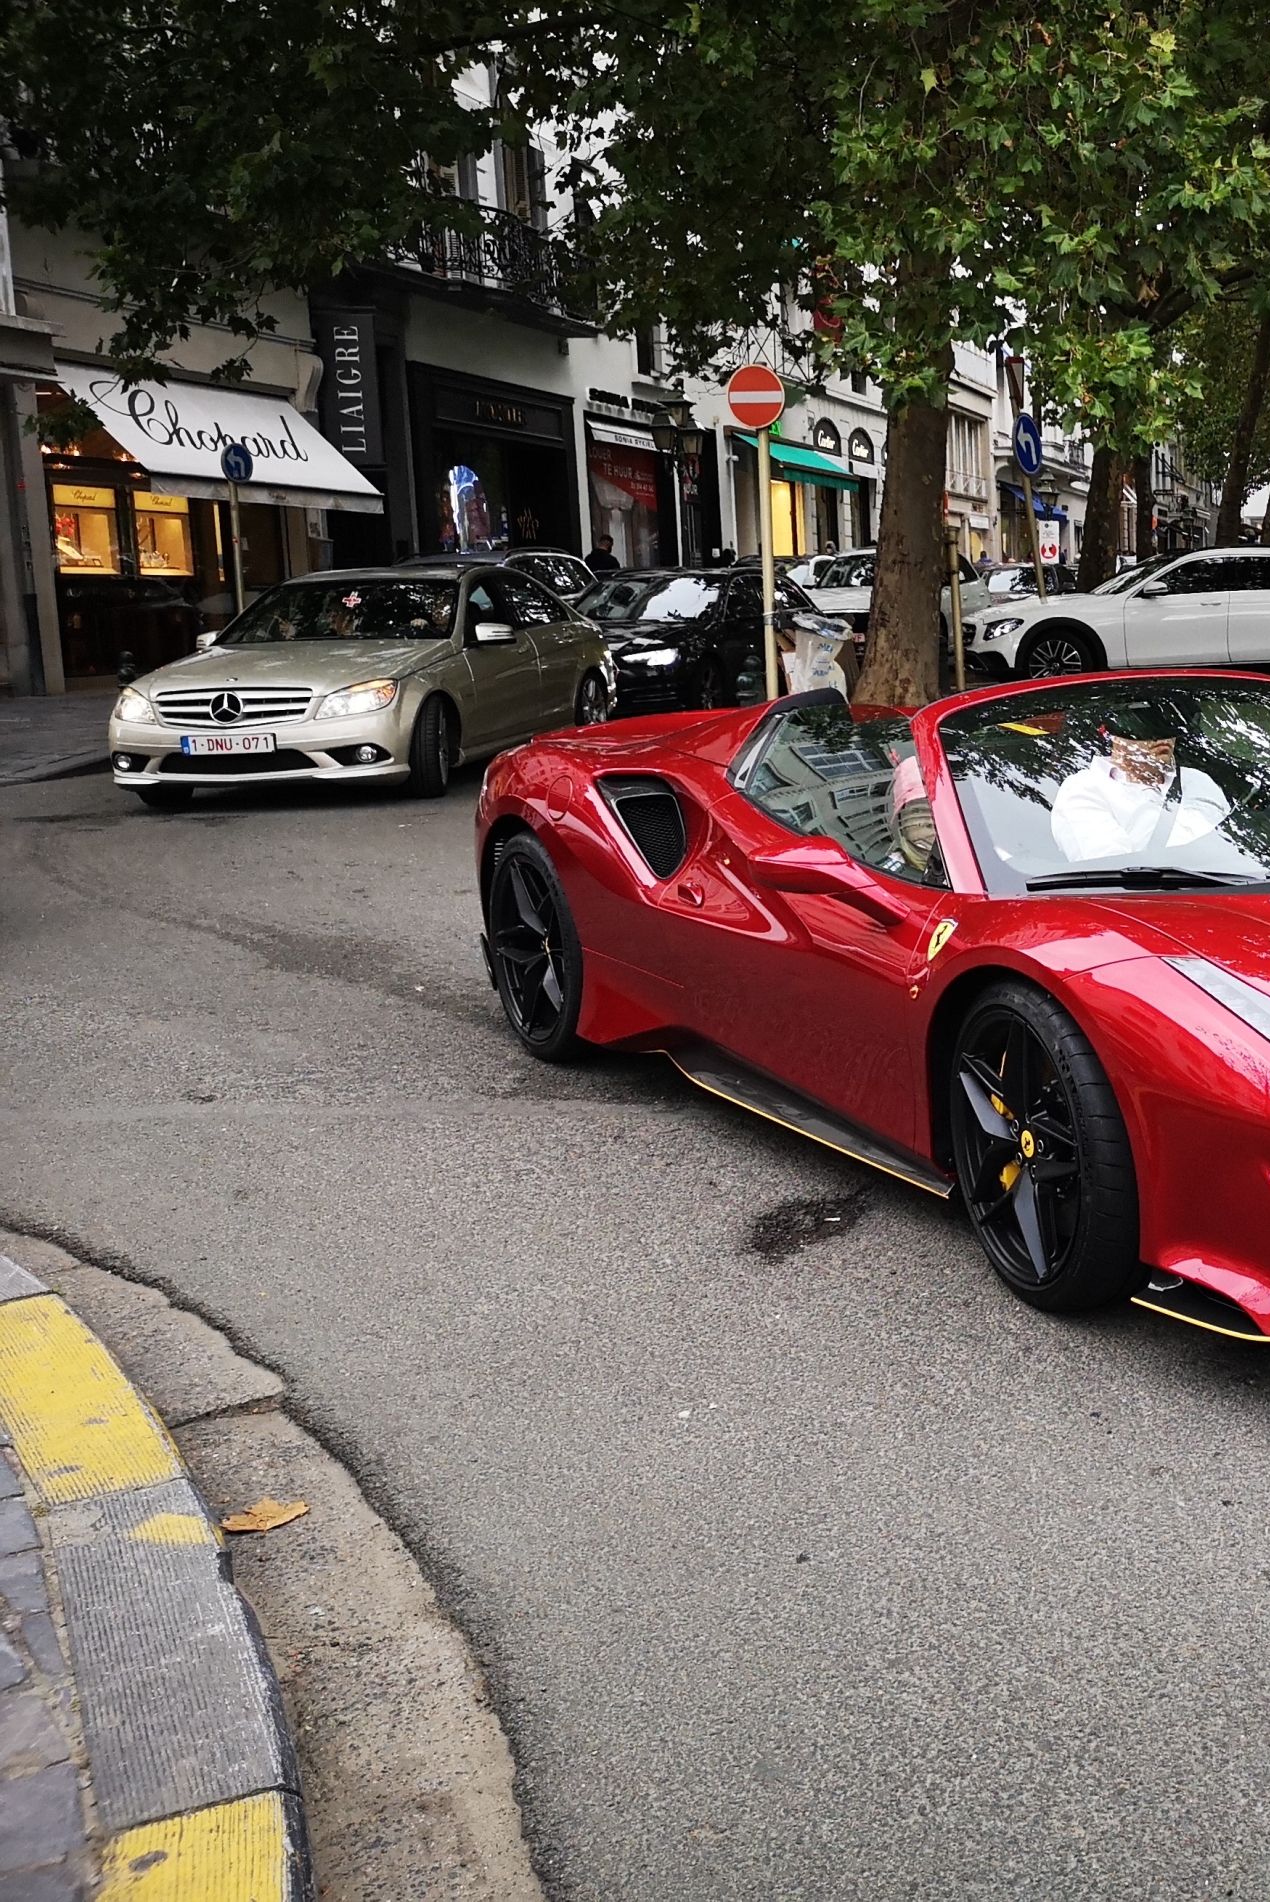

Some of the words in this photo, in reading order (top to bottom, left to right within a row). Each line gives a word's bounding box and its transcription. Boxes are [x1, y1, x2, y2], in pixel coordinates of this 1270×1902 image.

[333, 326, 366, 453] LIAIGRE
[614, 434, 633, 445] SONIA
[634, 438, 655, 449] RYKIEL
[818, 430, 835, 449] Cartier
[852, 439, 869, 458] Cartier
[603, 463, 613, 476] TE
[614, 465, 633, 479] HUUR
[191, 736, 269, 752] 1-DNU-071
